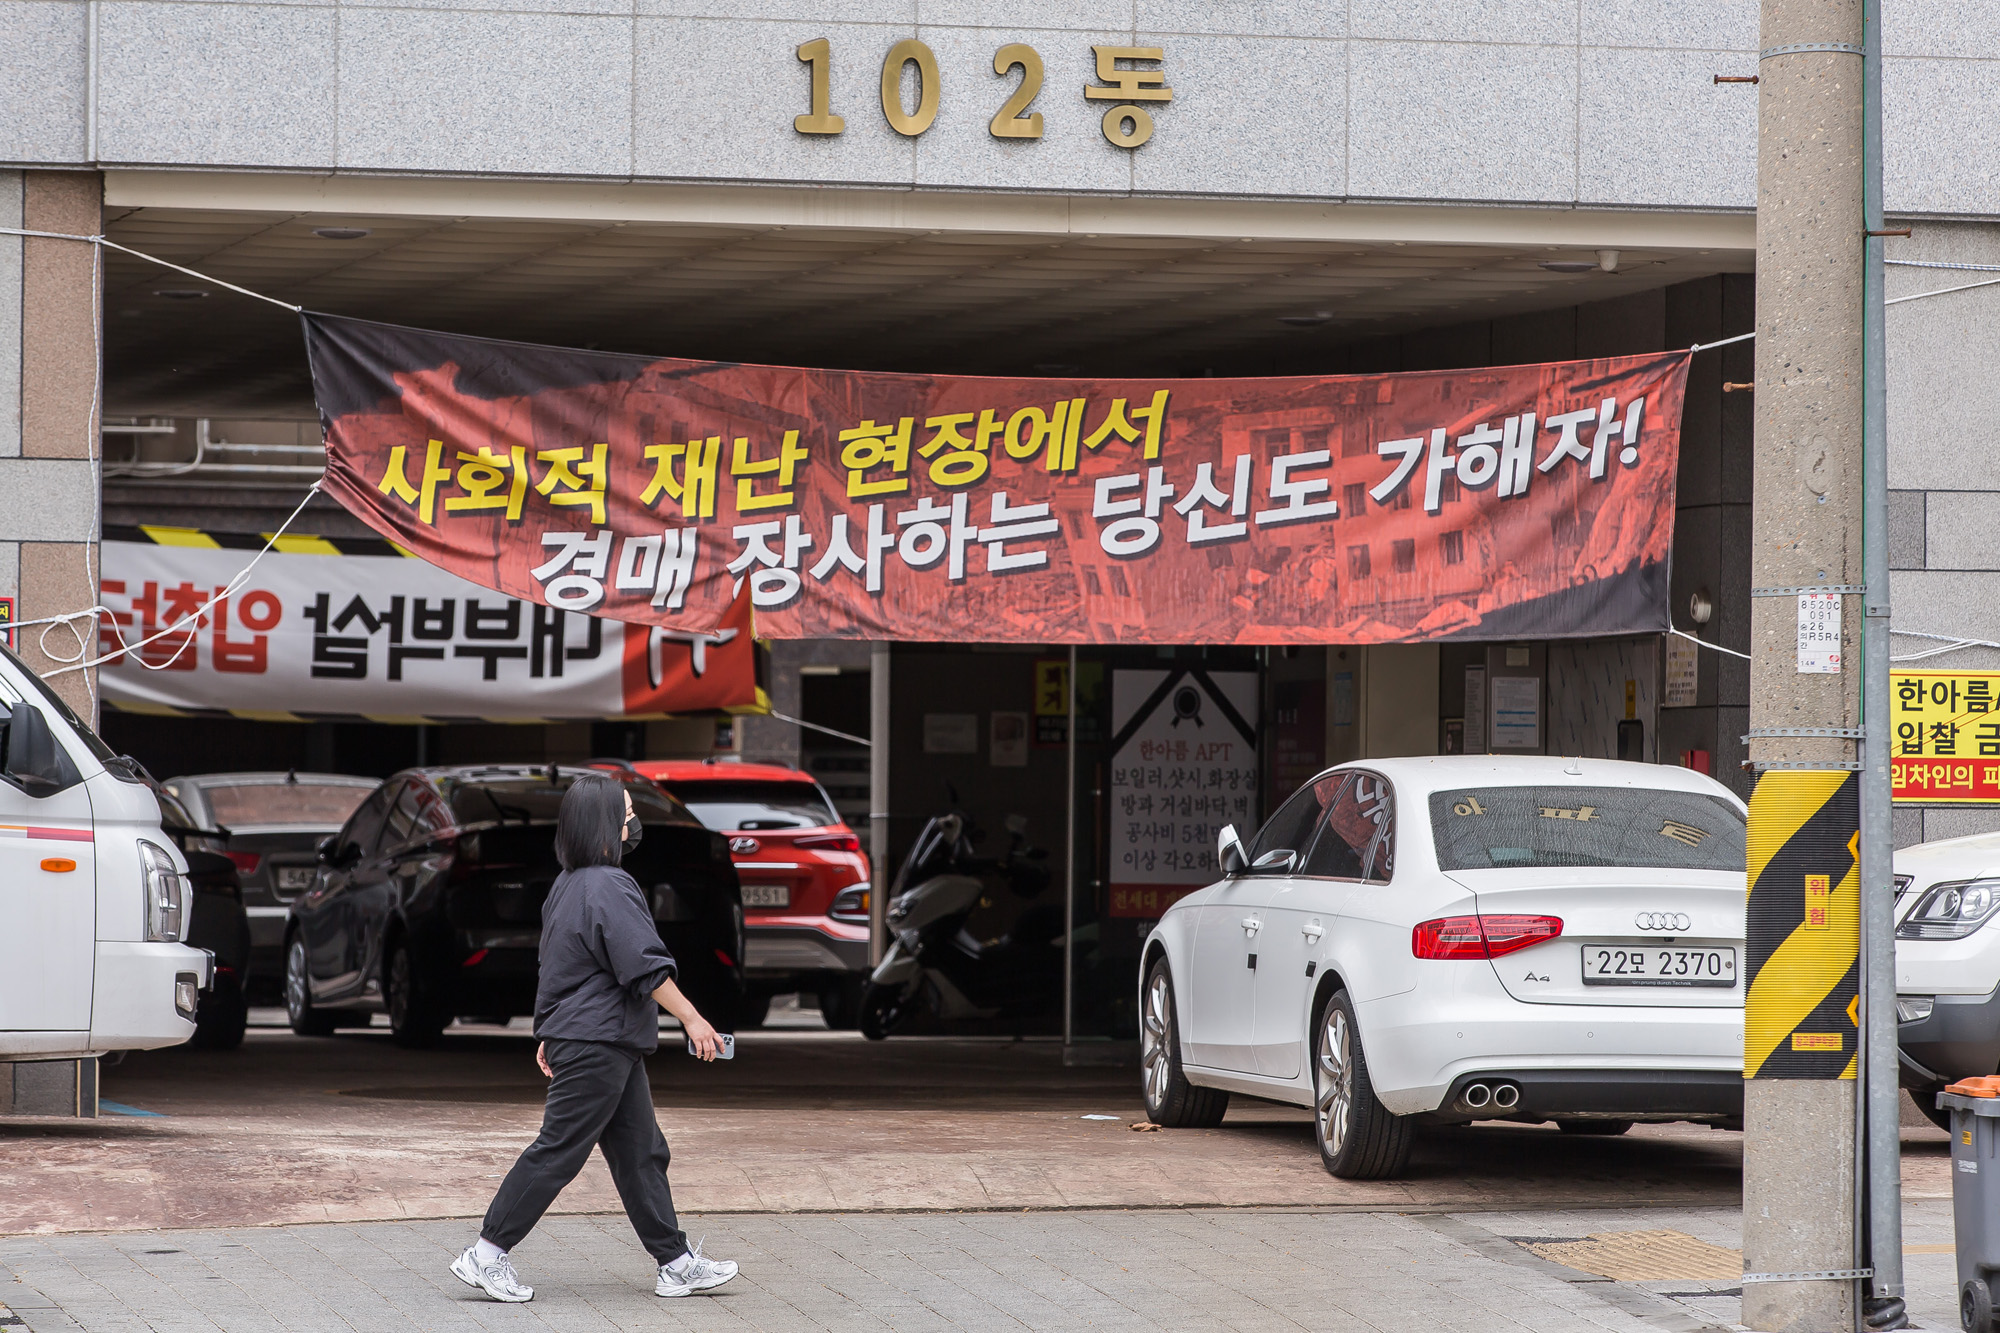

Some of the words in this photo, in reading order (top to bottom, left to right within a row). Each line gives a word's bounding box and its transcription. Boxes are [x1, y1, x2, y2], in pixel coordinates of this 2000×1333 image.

[794, 37, 1173, 149] 102동
[377, 438, 608, 524] 사회적
[637, 430, 808, 517] 재난
[837, 389, 1170, 498] 현장에서
[530, 526, 697, 610] 경매
[725, 491, 1059, 606] 장사하는
[1091, 450, 1338, 556] 당신도
[1367, 396, 1644, 512] 가해자!
[1809, 621, 1824, 631] 26
[1810, 610, 1831, 620] 091
[1809, 632, 1839, 641] R5R4
[1139, 739, 1189, 761] 한아름
[1195, 742, 1233, 761] APT
[1897, 721, 1960, 755] 입찰
[1891, 763, 1973, 790] 임차인의
[1126, 821, 1175, 844] 공사비
[1123, 848, 1158, 872] 이상
[1598, 950, 1645, 974] 22모
[1658, 951, 1721, 975] 2370
[1523, 970, 1551, 983] A4
